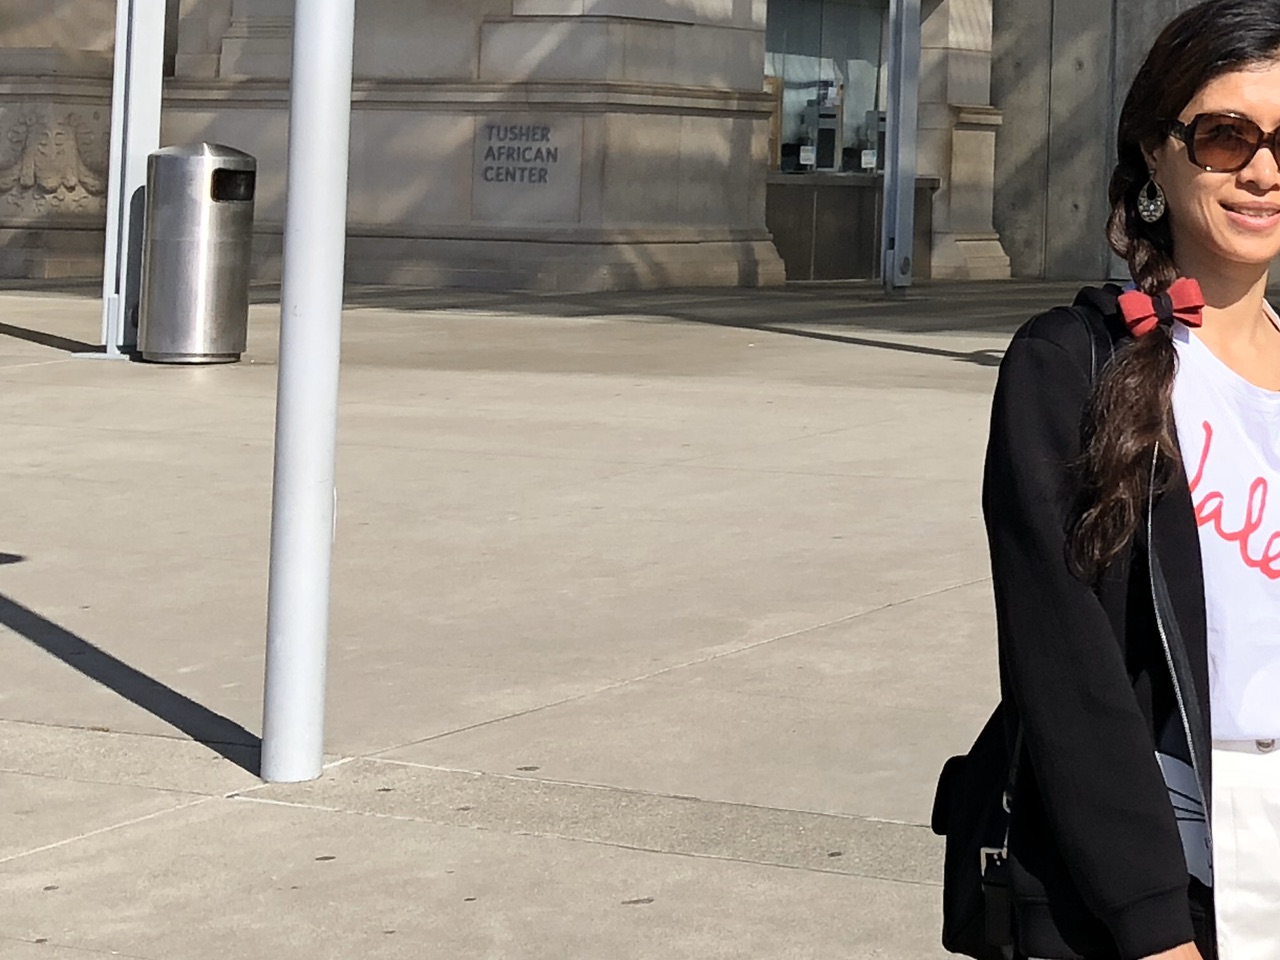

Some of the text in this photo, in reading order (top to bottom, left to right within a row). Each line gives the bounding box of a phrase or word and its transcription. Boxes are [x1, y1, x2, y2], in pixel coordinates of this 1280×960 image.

[486, 124, 551, 142] TUSHER
[484, 145, 558, 163] AFRICAN
[483, 166, 548, 184] CENTER
